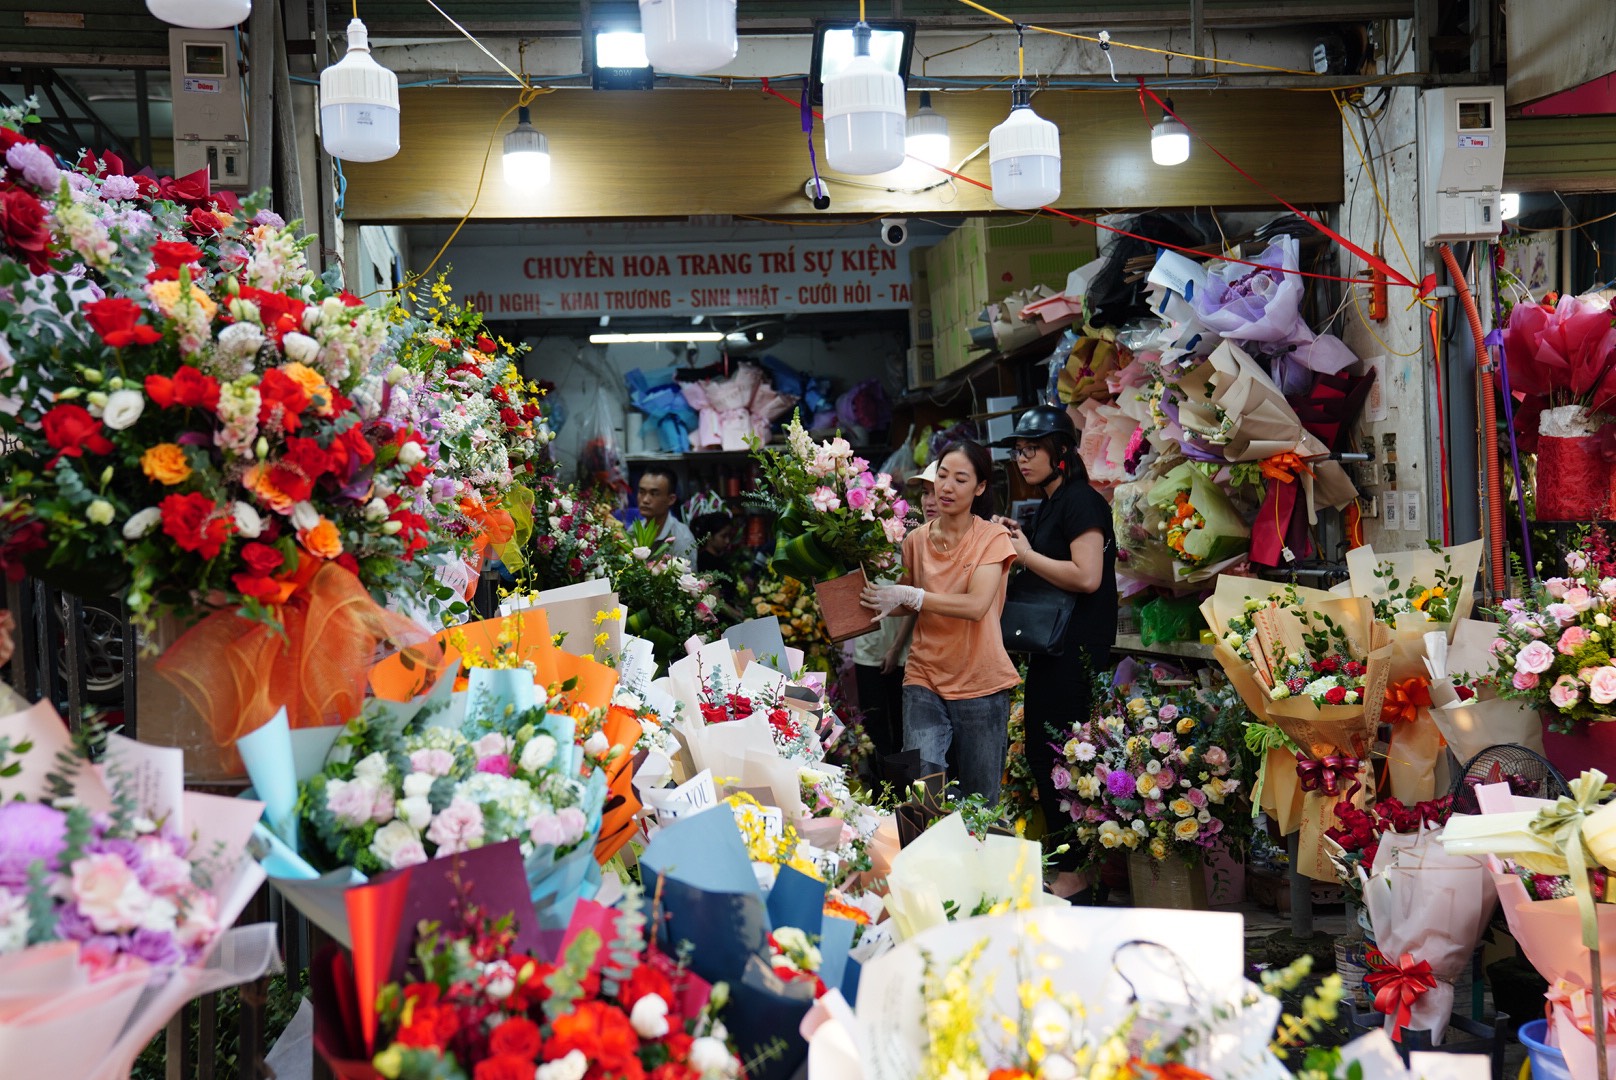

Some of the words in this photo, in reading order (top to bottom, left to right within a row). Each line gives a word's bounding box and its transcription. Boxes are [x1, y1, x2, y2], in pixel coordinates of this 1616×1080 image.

[613, 69, 632, 77] 30W
[523, 251, 615, 279] CHUYÊN
[622, 255, 671, 277] HOA
[676, 253, 752, 276] TRANG
[758, 245, 796, 273] TRÍ
[803, 249, 834, 278] SỰ
[841, 243, 896, 277] KIỆN
[499, 292, 541, 315] NGHỊ
[560, 291, 600, 311] KHAI
[604, 289, 671, 309] TRƯƠNG
[691, 287, 730, 308] SINH
[737, 284, 780, 309] NHẬT
[798, 282, 837, 304] CƯỚI
[844, 280, 871, 304] HỎI
